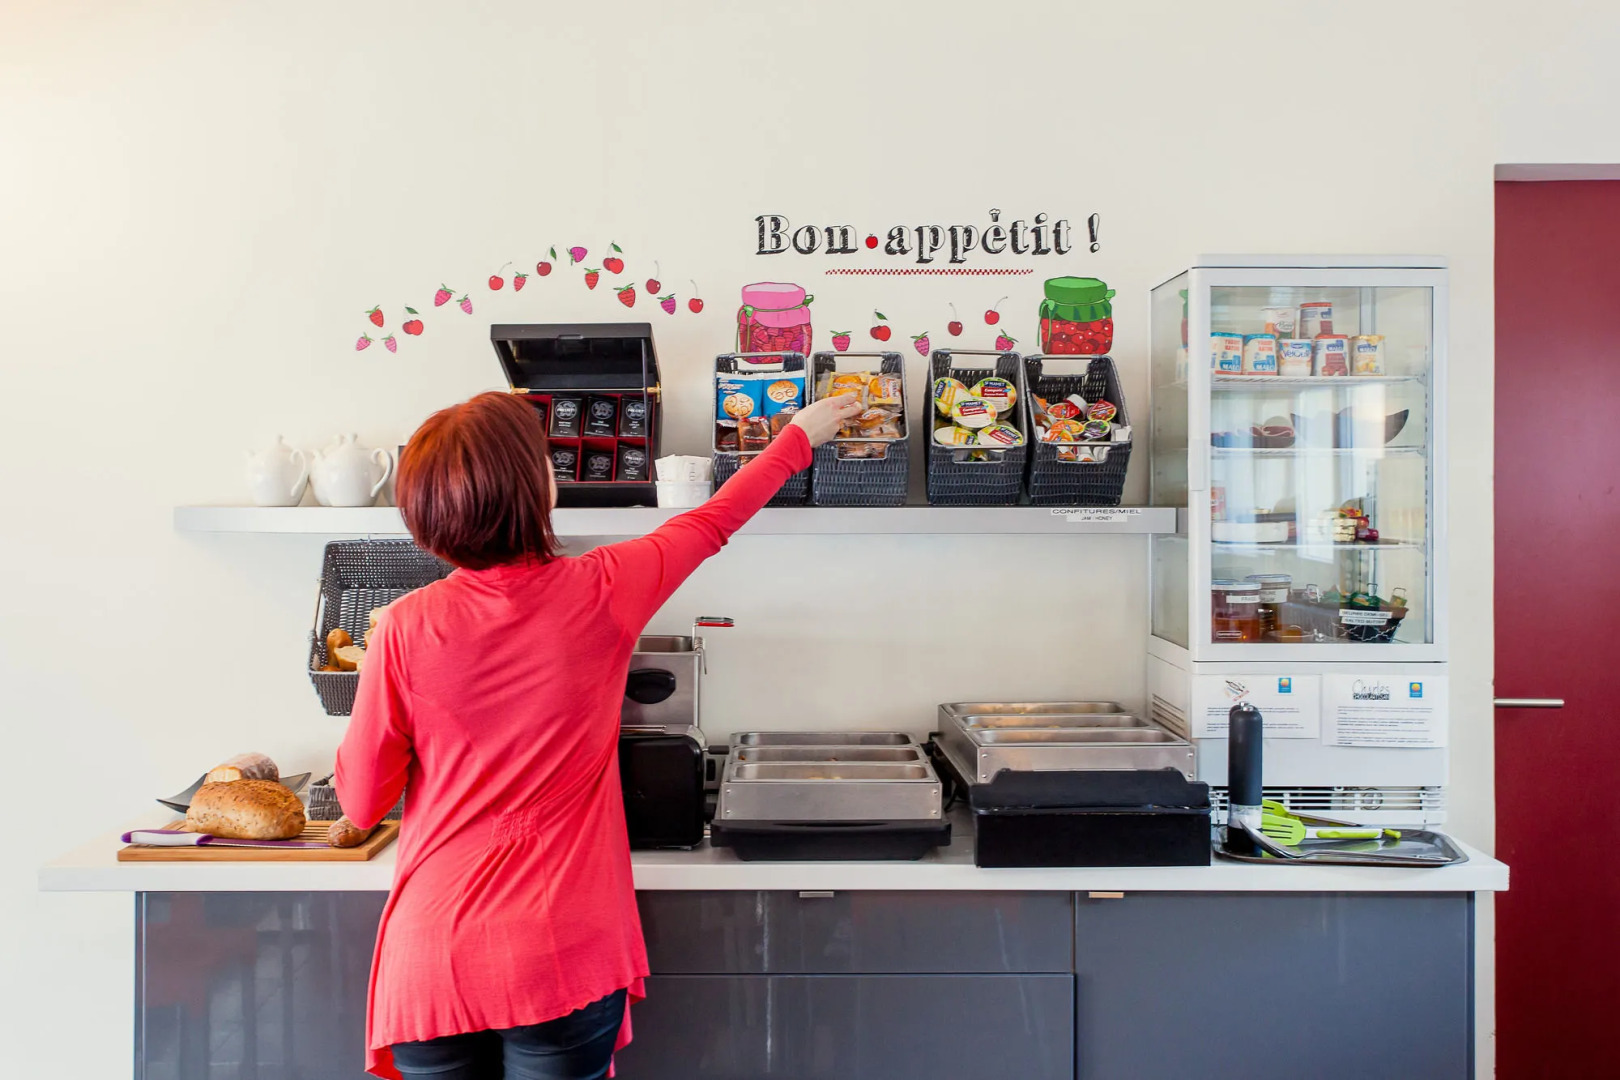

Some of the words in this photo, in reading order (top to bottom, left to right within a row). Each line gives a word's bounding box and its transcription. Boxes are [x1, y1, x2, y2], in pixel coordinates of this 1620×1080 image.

[754, 213, 859, 256] Bon
[884, 209, 1072, 265] appétit
[1087, 213, 1101, 255] !
